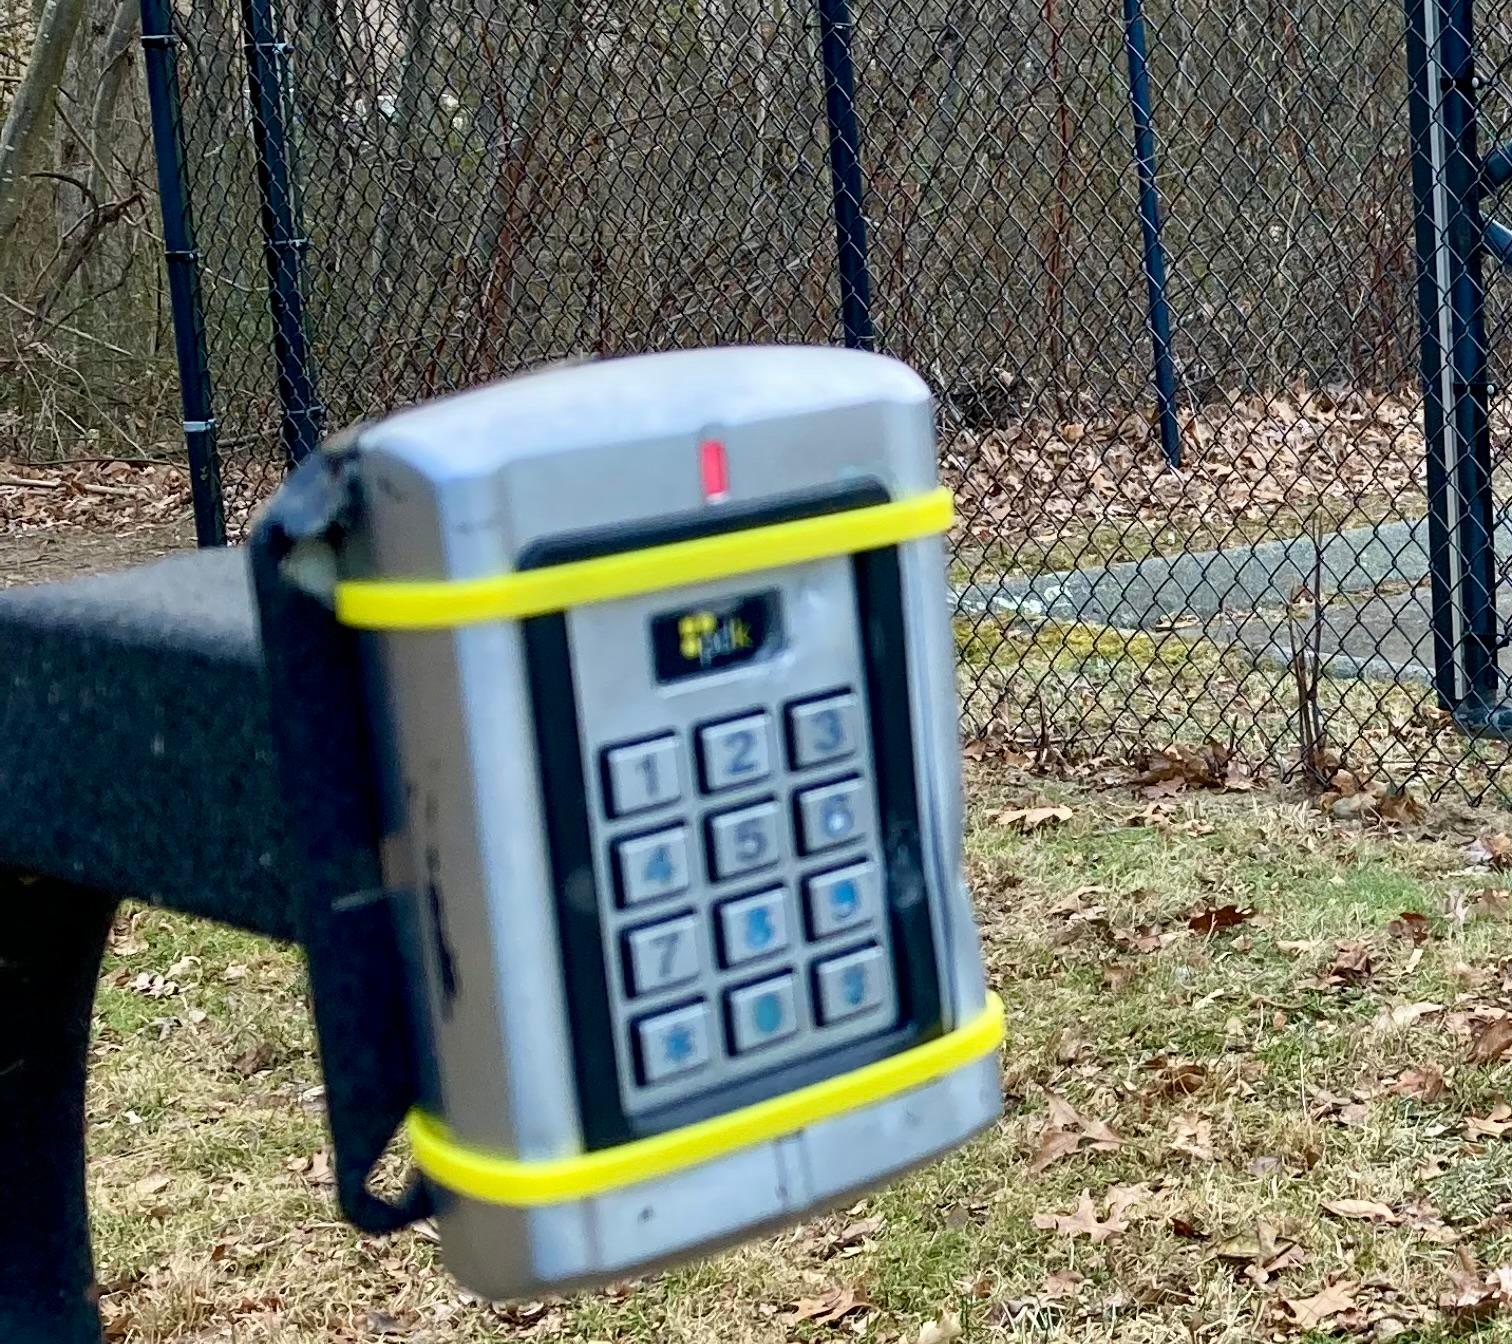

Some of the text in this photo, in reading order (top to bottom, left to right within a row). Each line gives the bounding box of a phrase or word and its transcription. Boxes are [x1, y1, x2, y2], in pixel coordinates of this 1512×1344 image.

[635, 710, 843, 797] 1 2 3
[734, 816, 768, 864] 5
[820, 792, 854, 838] 6
[650, 932, 679, 978] 7
